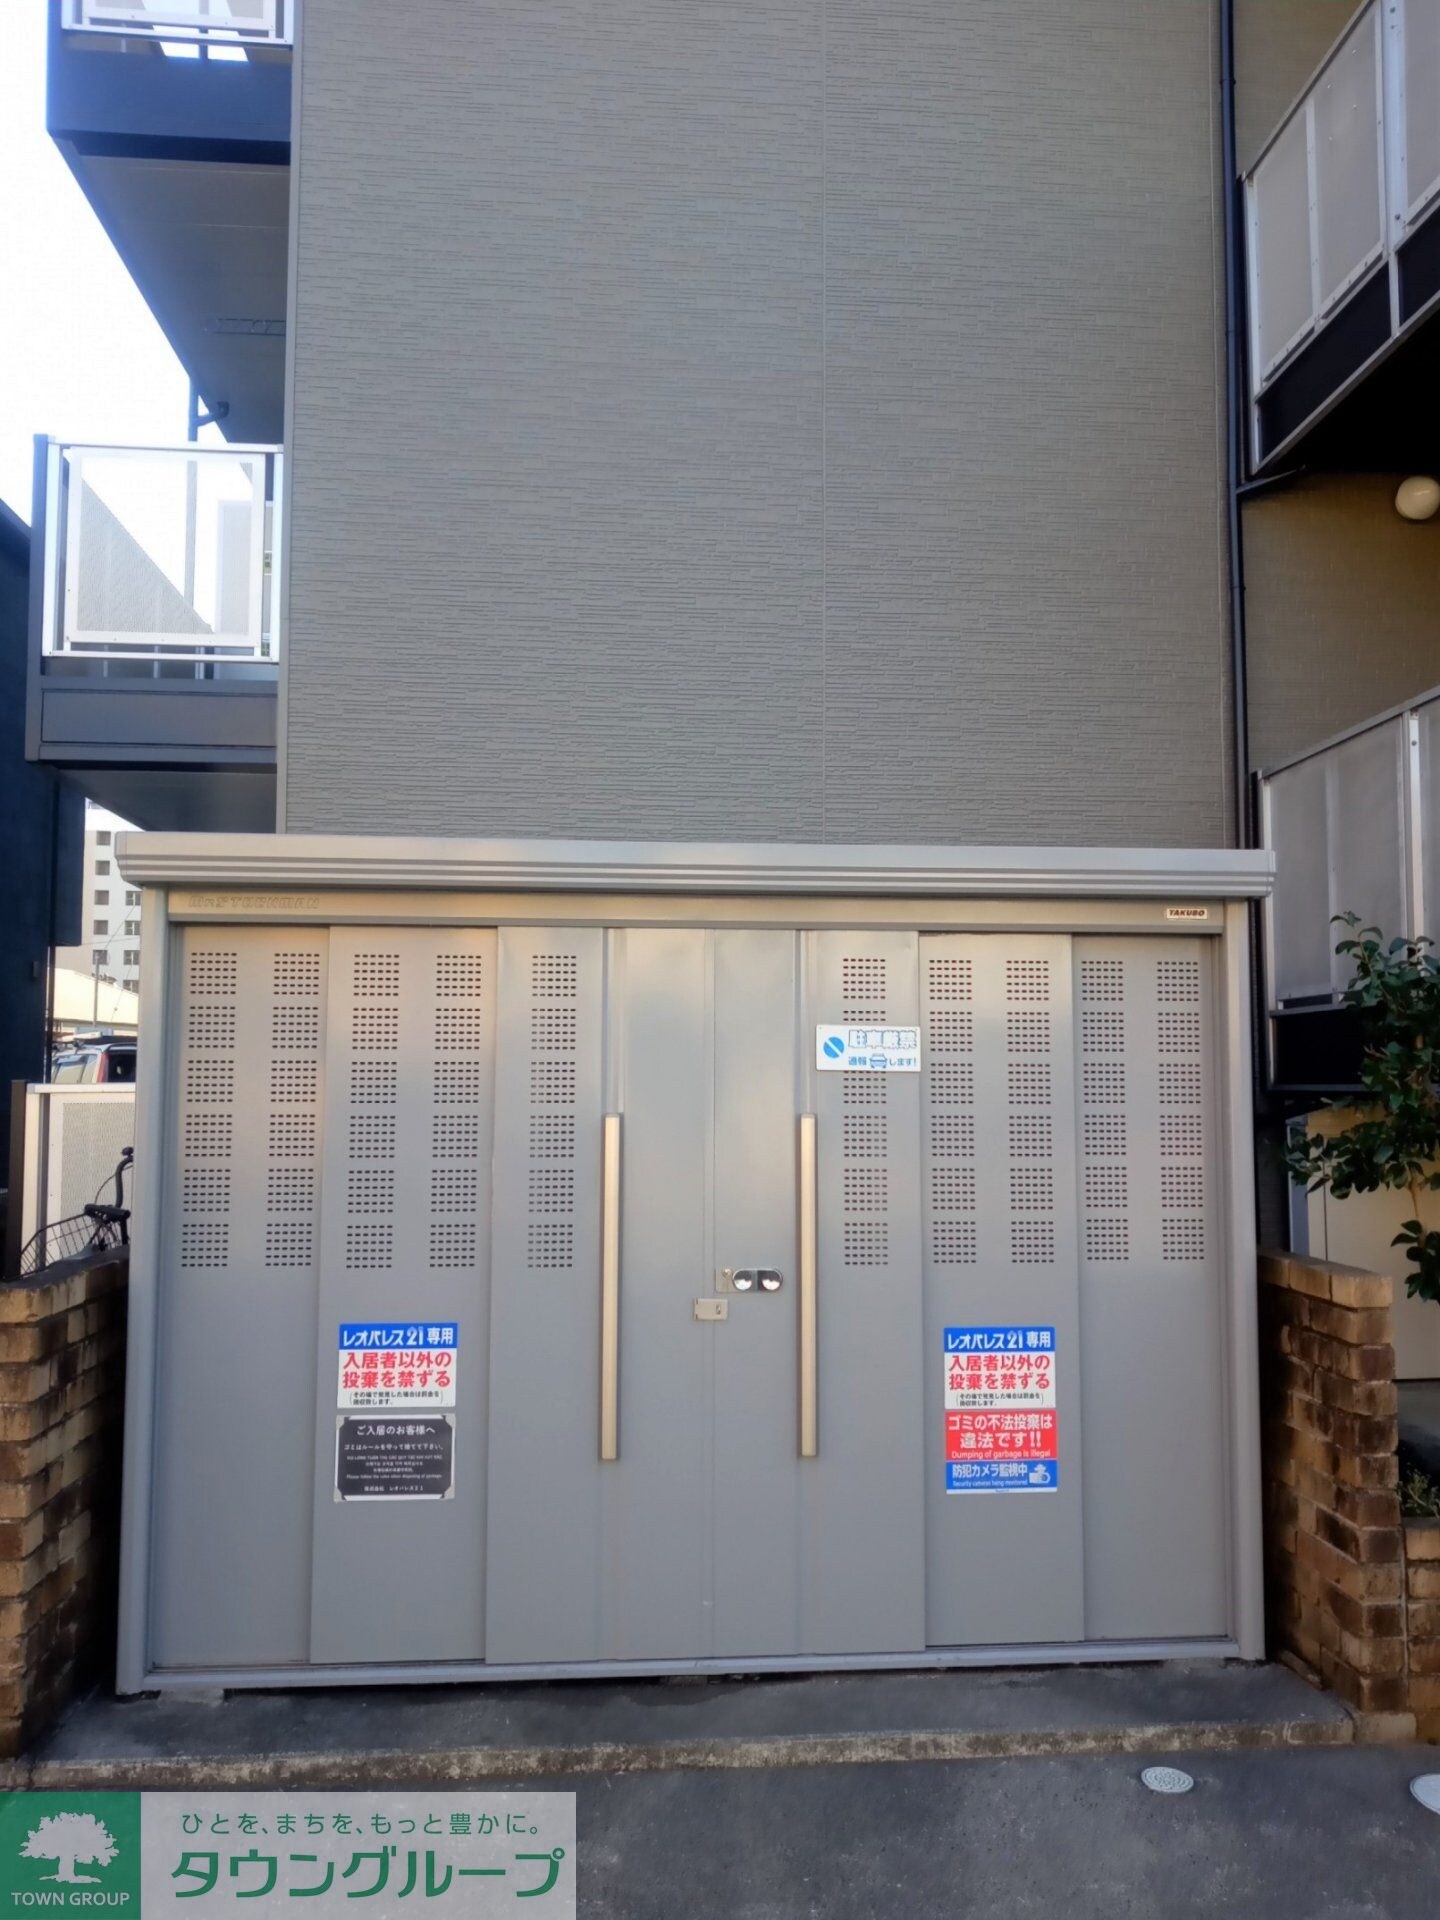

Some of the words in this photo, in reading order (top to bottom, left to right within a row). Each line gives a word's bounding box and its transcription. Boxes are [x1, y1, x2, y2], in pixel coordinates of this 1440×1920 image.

[1169, 909, 1205, 917] TAKUBO
[343, 1352, 451, 1370] 入居者以外の
[949, 1355, 1050, 1372] 入居者以外の
[342, 1370, 451, 1389] 投棄を禁ずる
[949, 1373, 1050, 1391] 投棄を禁ずる
[357, 1424, 436, 1436] ご入居のお客様へ
[948, 1414, 1053, 1430] ゴミの不法投棄は
[951, 1450, 984, 1460] Dumping
[984, 1450, 993, 1458] of
[993, 1450, 1022, 1460] garbage
[952, 1462, 1028, 1478] 防犯カメラ監視中
